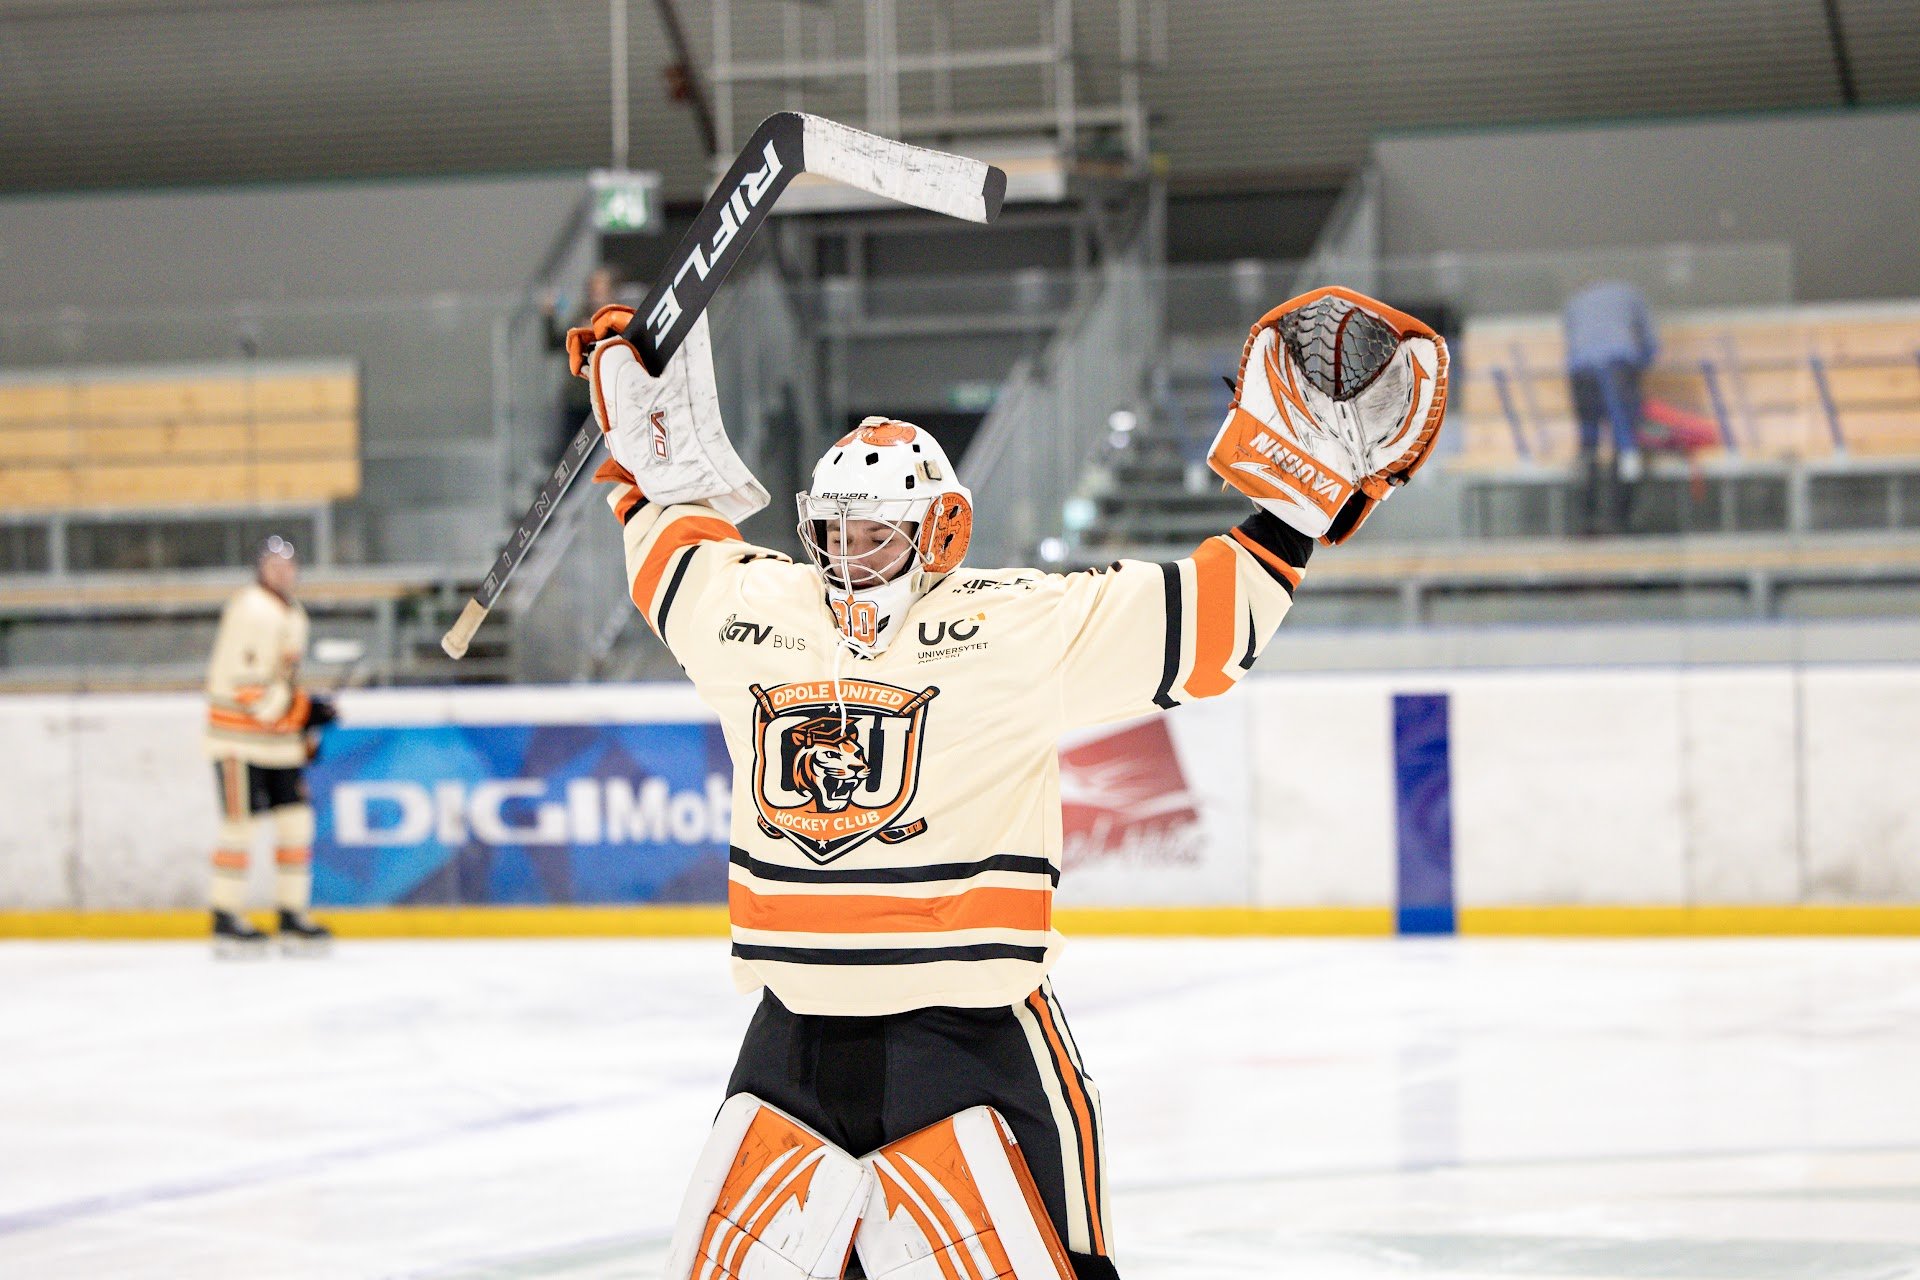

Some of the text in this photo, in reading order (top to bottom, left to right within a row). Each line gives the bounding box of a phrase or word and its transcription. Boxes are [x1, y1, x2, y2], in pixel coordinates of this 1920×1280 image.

[646, 139, 783, 349] RIFLE
[1248, 430, 1344, 503] VAUGHN
[725, 621, 806, 651] GTV BUS
[917, 641, 989, 659] UNIWERSYTET
[773, 683, 904, 706] OPOLE UNITED
[331, 778, 600, 848] DIGI
[774, 810, 881, 832] HOCKEY CLUB
